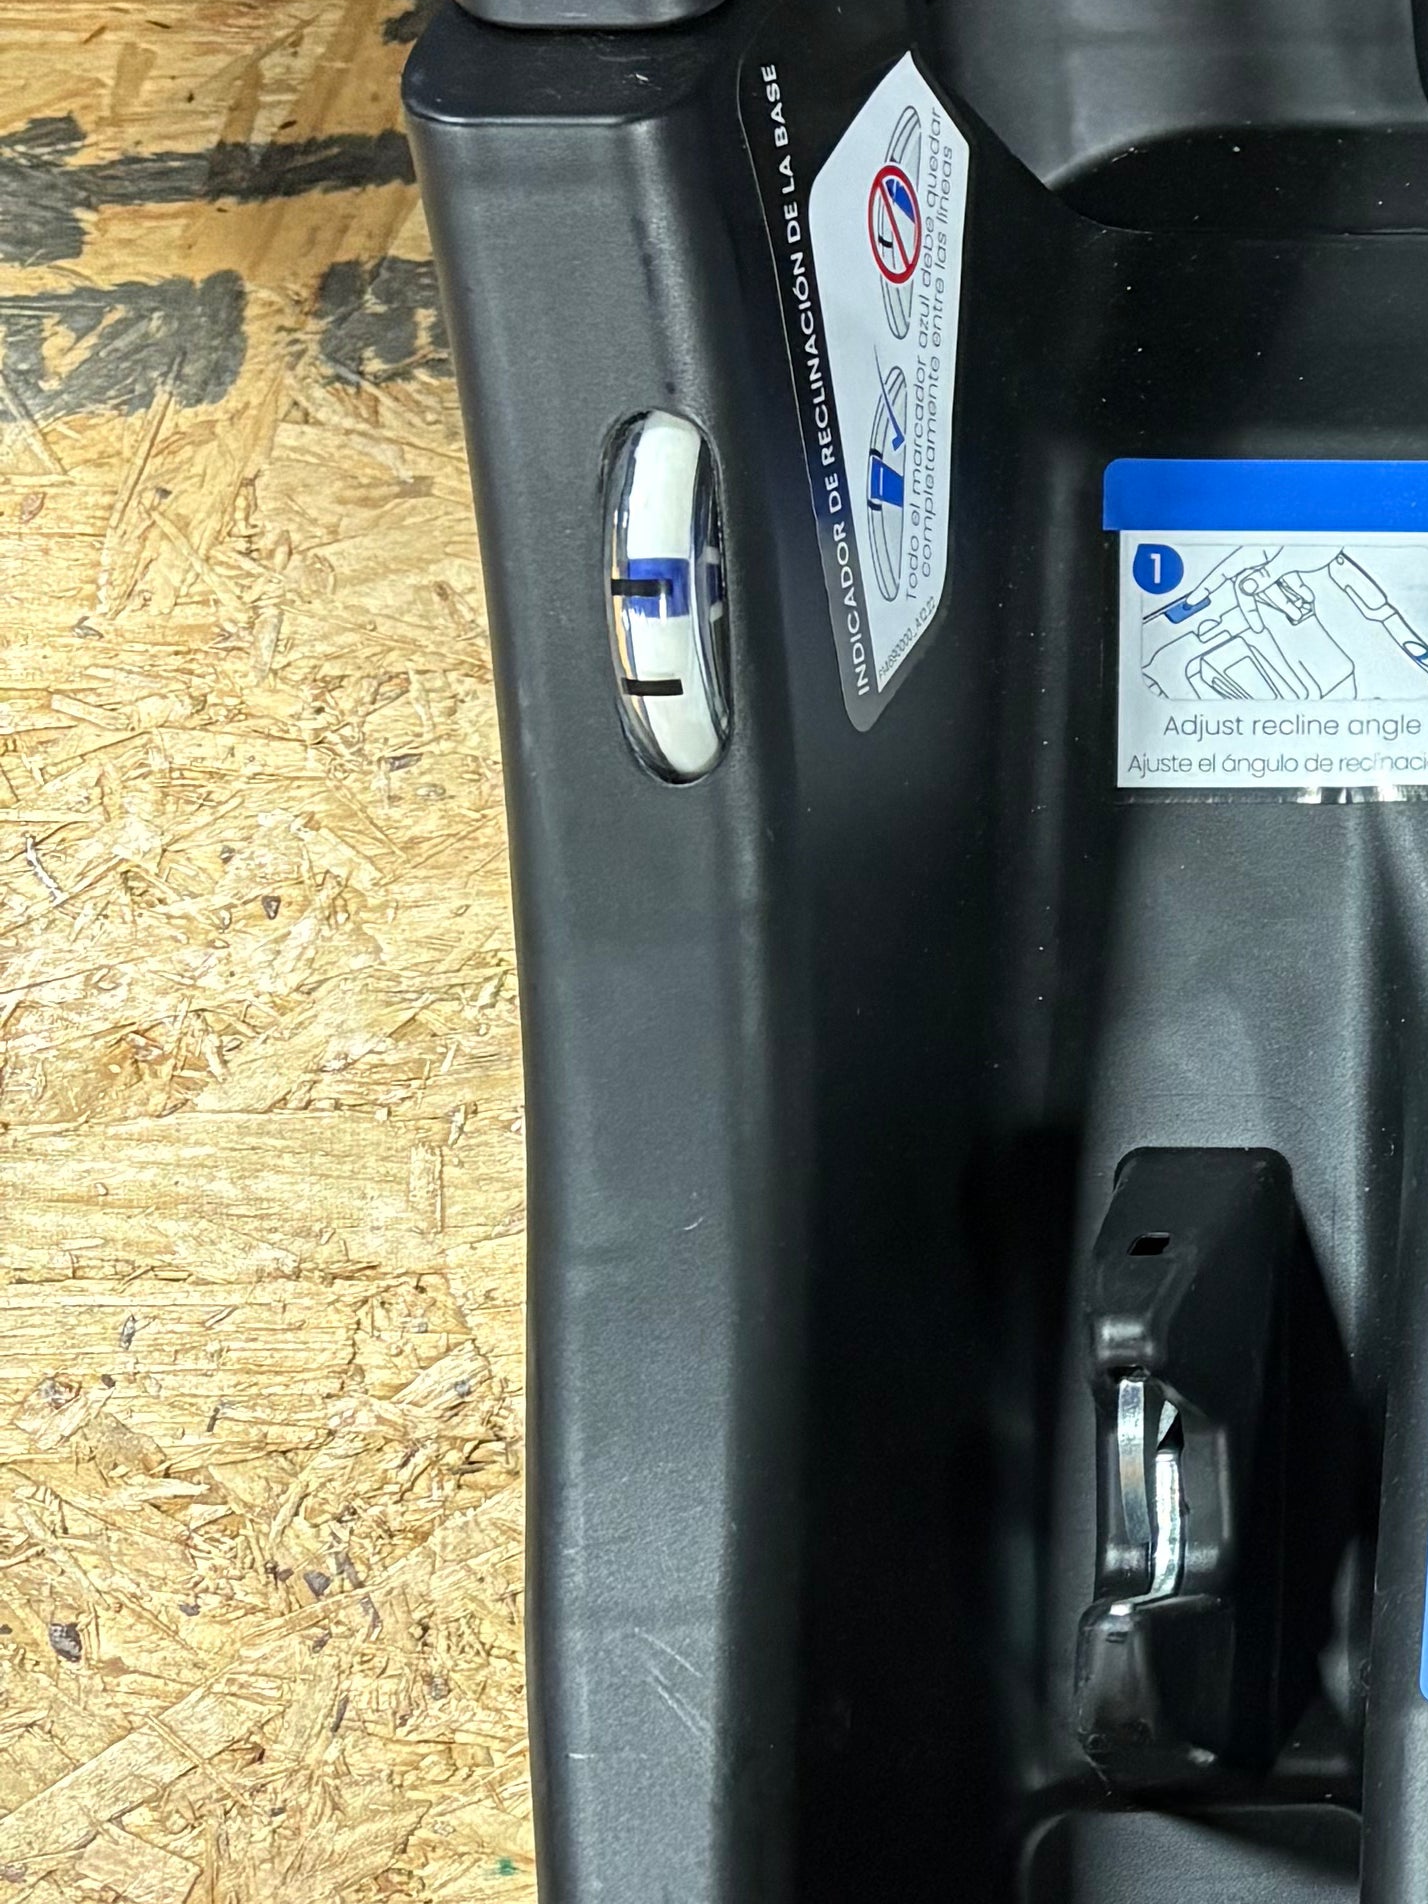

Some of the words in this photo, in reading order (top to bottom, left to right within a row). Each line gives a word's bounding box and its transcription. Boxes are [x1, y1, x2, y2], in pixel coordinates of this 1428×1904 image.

[761, 63, 789, 147] BASE
[779, 154, 796, 194] LA
[926, 106, 943, 212] quedar
[936, 145, 953, 225] líneas
[783, 200, 802, 245] DE
[920, 216, 935, 287] debe
[934, 230, 948, 271] las
[917, 292, 930, 349] azul
[931, 277, 945, 348] entre
[790, 251, 835, 467] RECLINACIÓN
[911, 355, 927, 494] marcador
[824, 472, 843, 515] DE
[920, 356, 941, 578] completamente
[910, 501, 921, 527] el
[906, 548, 920, 601] Todo
[1149, 553, 1161, 584] 1
[833, 521, 870, 696] INDICADOR
[1162, 713, 1244, 743] Adjust
[1251, 713, 1340, 736] recline
[1347, 713, 1422, 741] angle
